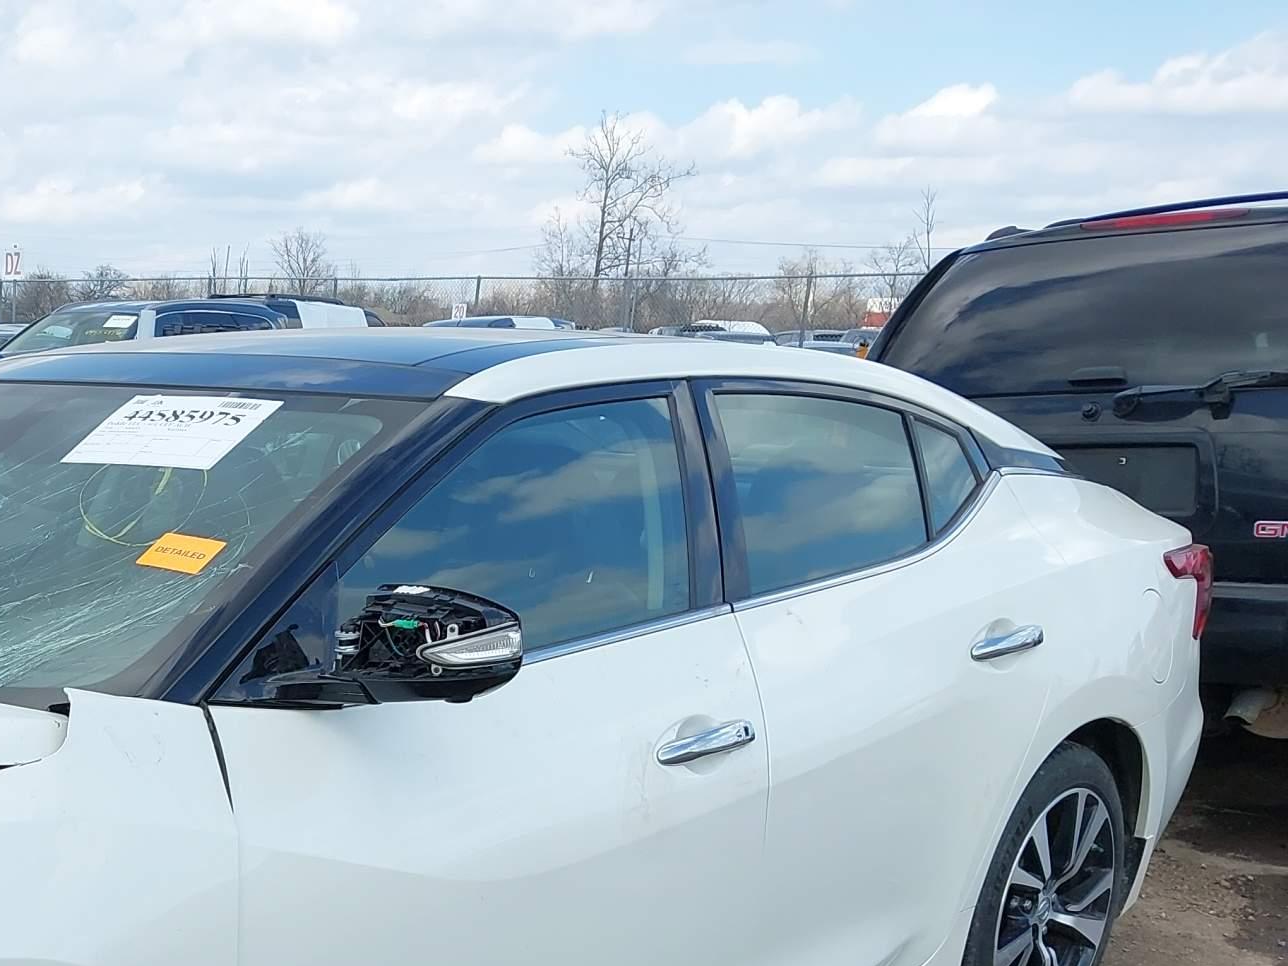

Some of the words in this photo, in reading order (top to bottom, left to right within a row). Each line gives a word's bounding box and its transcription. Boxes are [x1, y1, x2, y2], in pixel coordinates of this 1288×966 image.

[5, 252, 21, 275] DZ
[123, 409, 246, 427] 44585975
[154, 546, 206, 561] DETAILED
